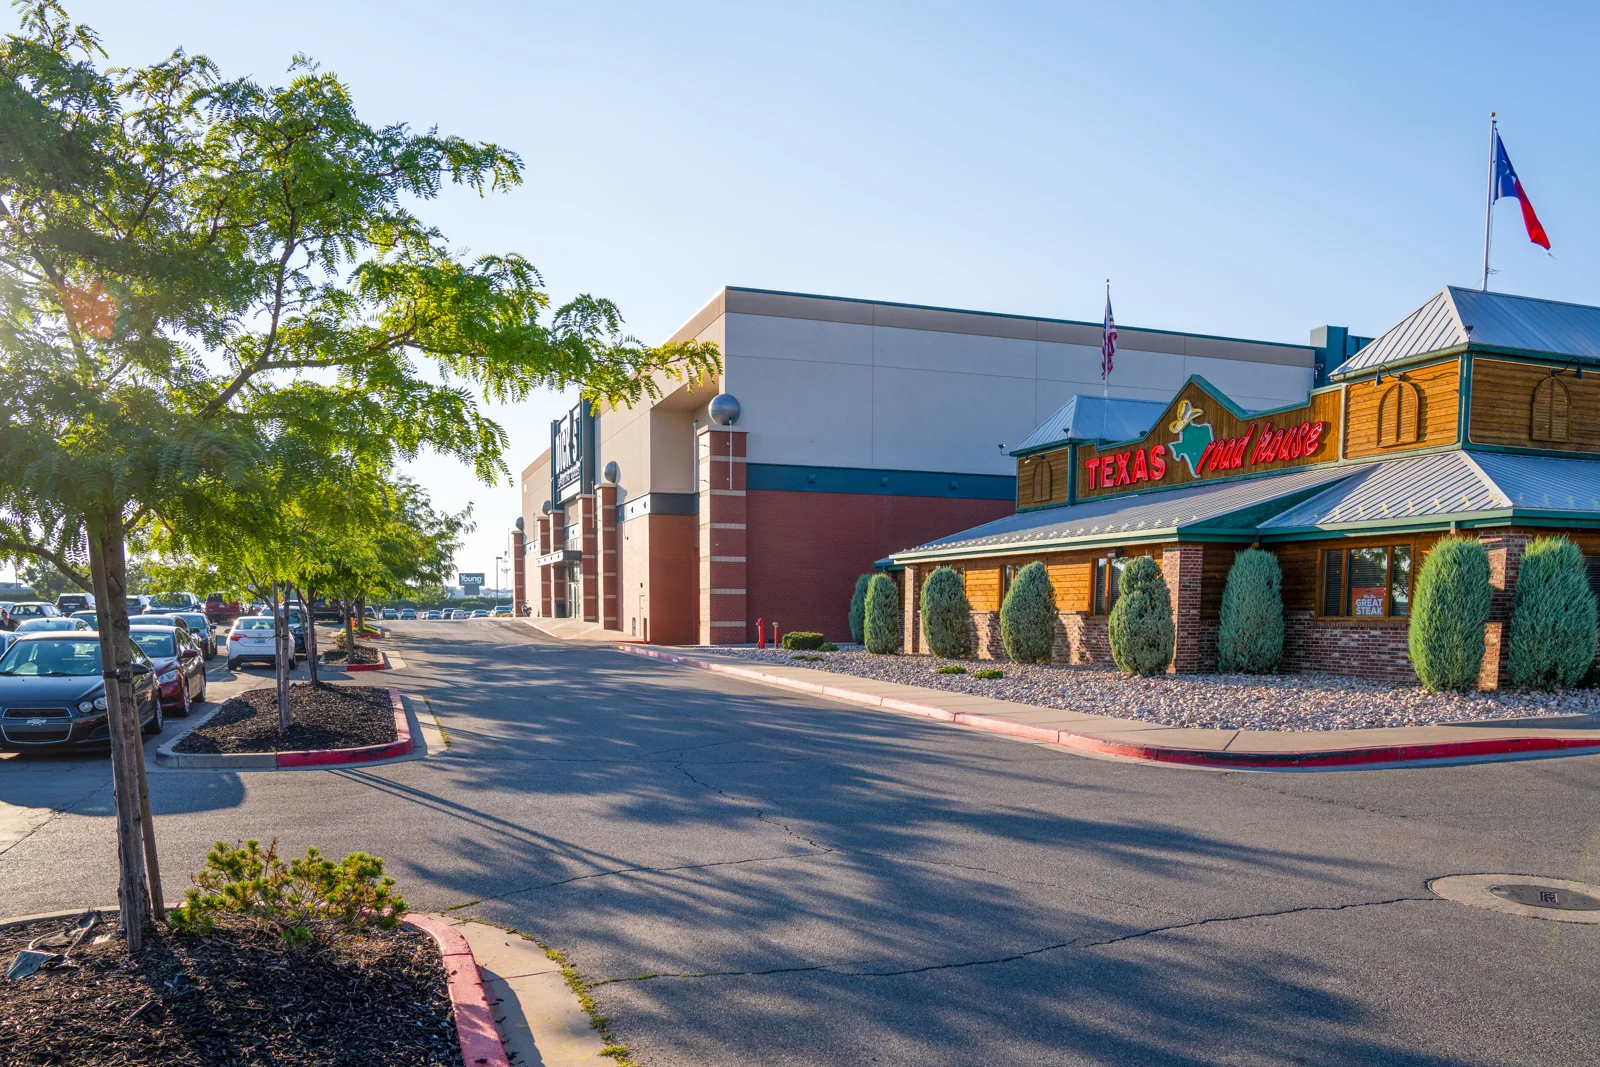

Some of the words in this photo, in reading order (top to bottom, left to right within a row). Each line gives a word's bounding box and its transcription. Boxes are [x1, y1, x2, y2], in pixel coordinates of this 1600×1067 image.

[555, 419, 578, 475] DICKS
[1085, 444, 1167, 490] TEXAS
[460, 574, 482, 584] Young
[1356, 598, 1383, 606] GREAT
[1356, 607, 1383, 615] STEAK
